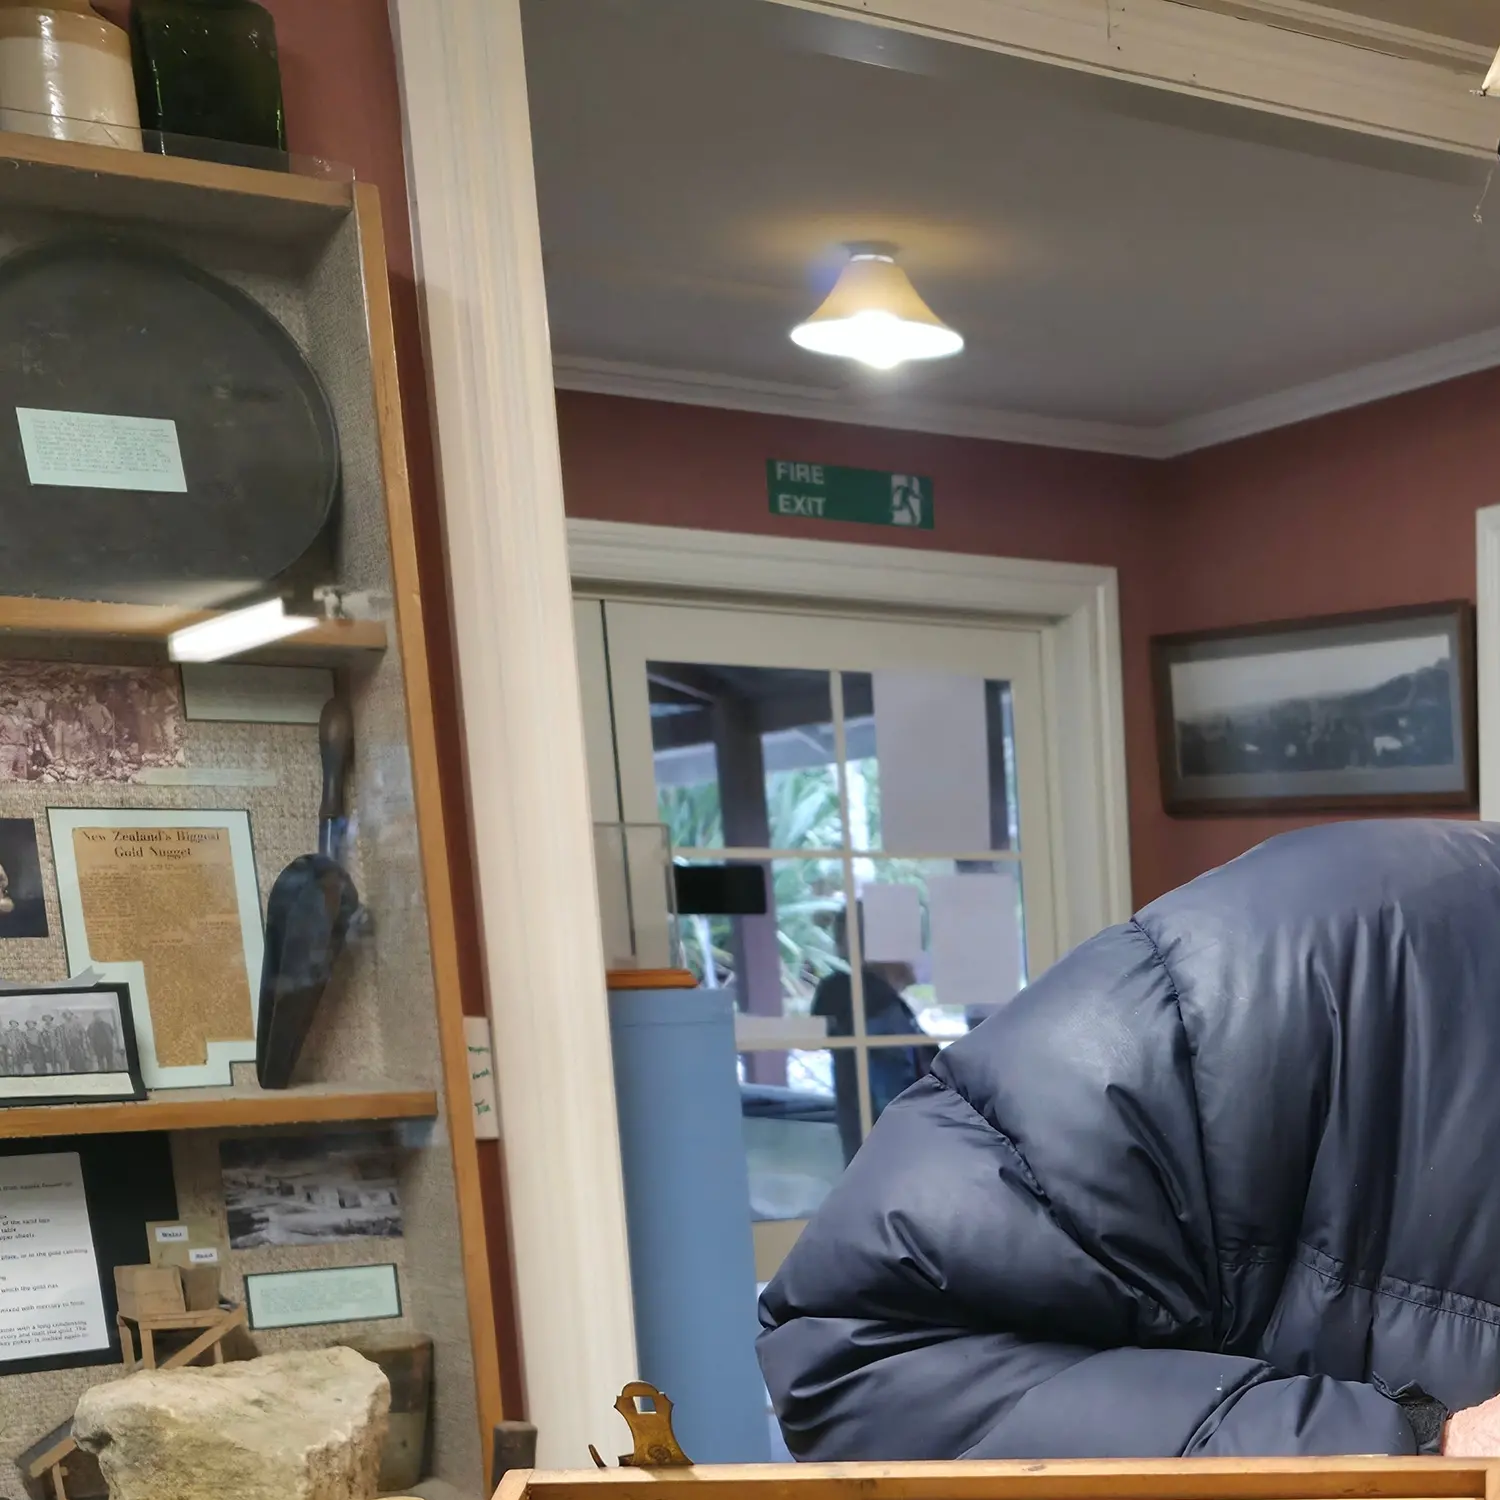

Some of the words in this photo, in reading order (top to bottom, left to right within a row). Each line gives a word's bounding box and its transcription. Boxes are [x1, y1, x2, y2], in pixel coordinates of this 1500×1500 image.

[775, 461, 825, 485] FIRE
[778, 494, 826, 516] EXIT
[114, 846, 143, 858] Gold
[149, 846, 191, 859] Nugget
